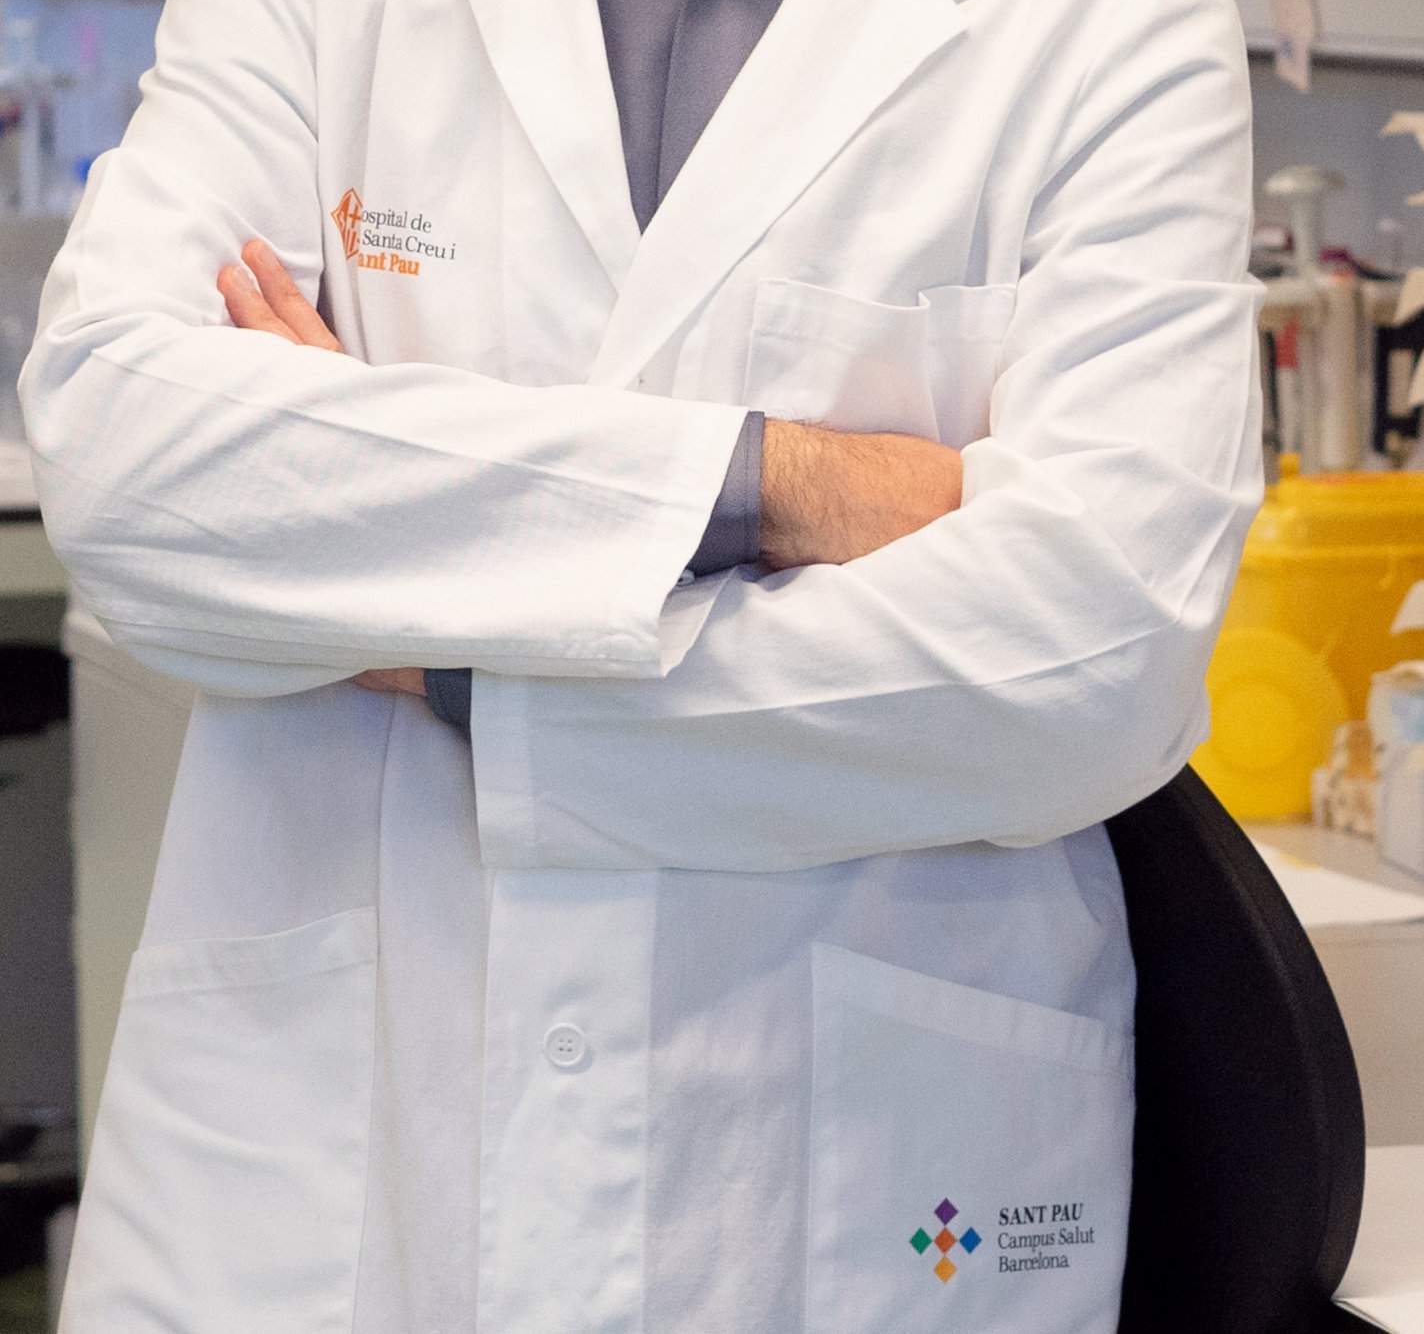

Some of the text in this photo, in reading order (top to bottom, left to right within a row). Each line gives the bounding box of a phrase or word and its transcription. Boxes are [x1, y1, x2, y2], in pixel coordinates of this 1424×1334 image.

[410, 214, 432, 234] de
[362, 230, 456, 260] Santa Creu i
[389, 254, 420, 276] Pau
[999, 1203, 1084, 1226] SANT PAU
[998, 1226, 1095, 1253] Campus Salut
[998, 1252, 1069, 1273] Barcelona
